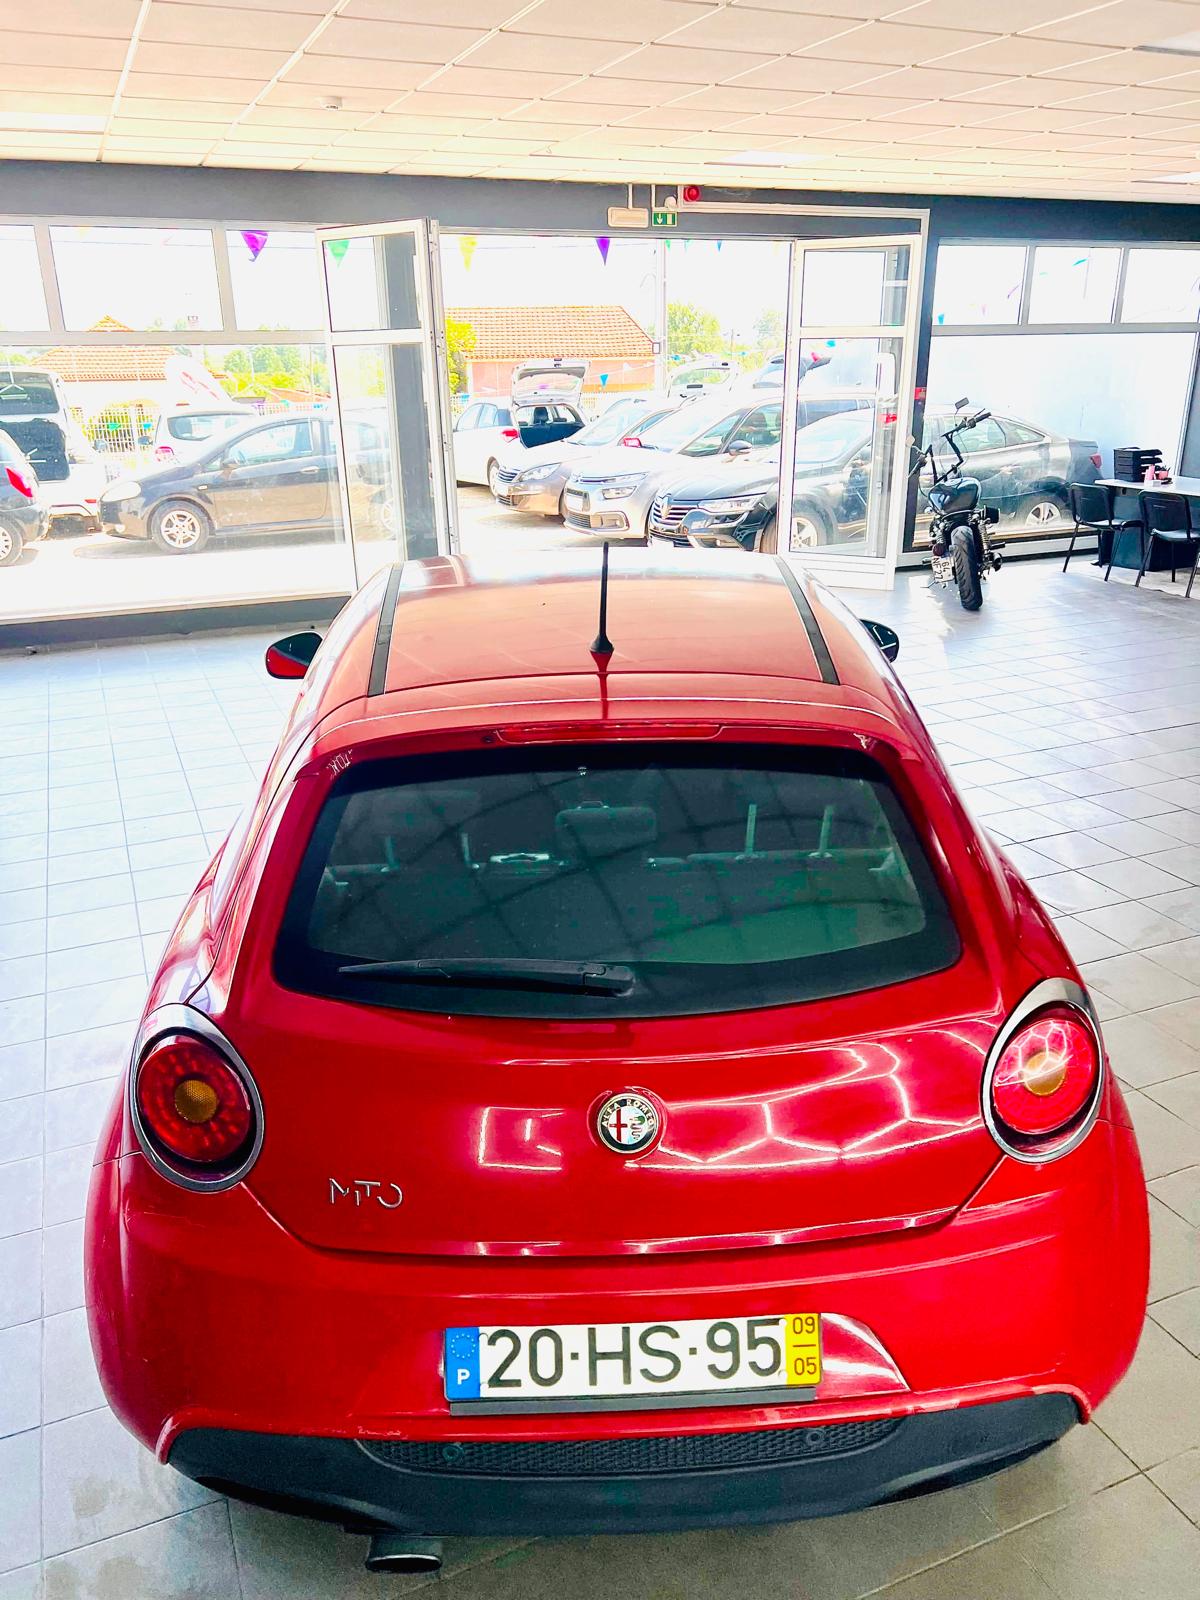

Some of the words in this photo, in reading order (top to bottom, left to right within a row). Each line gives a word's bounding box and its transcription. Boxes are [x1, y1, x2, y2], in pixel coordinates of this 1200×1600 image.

[601, 1102, 621, 1128] ALFA
[626, 1098, 654, 1127] ROMEO
[792, 1316, 816, 1335] 09
[457, 1368, 470, 1385] P
[793, 1356, 817, 1377] 05
